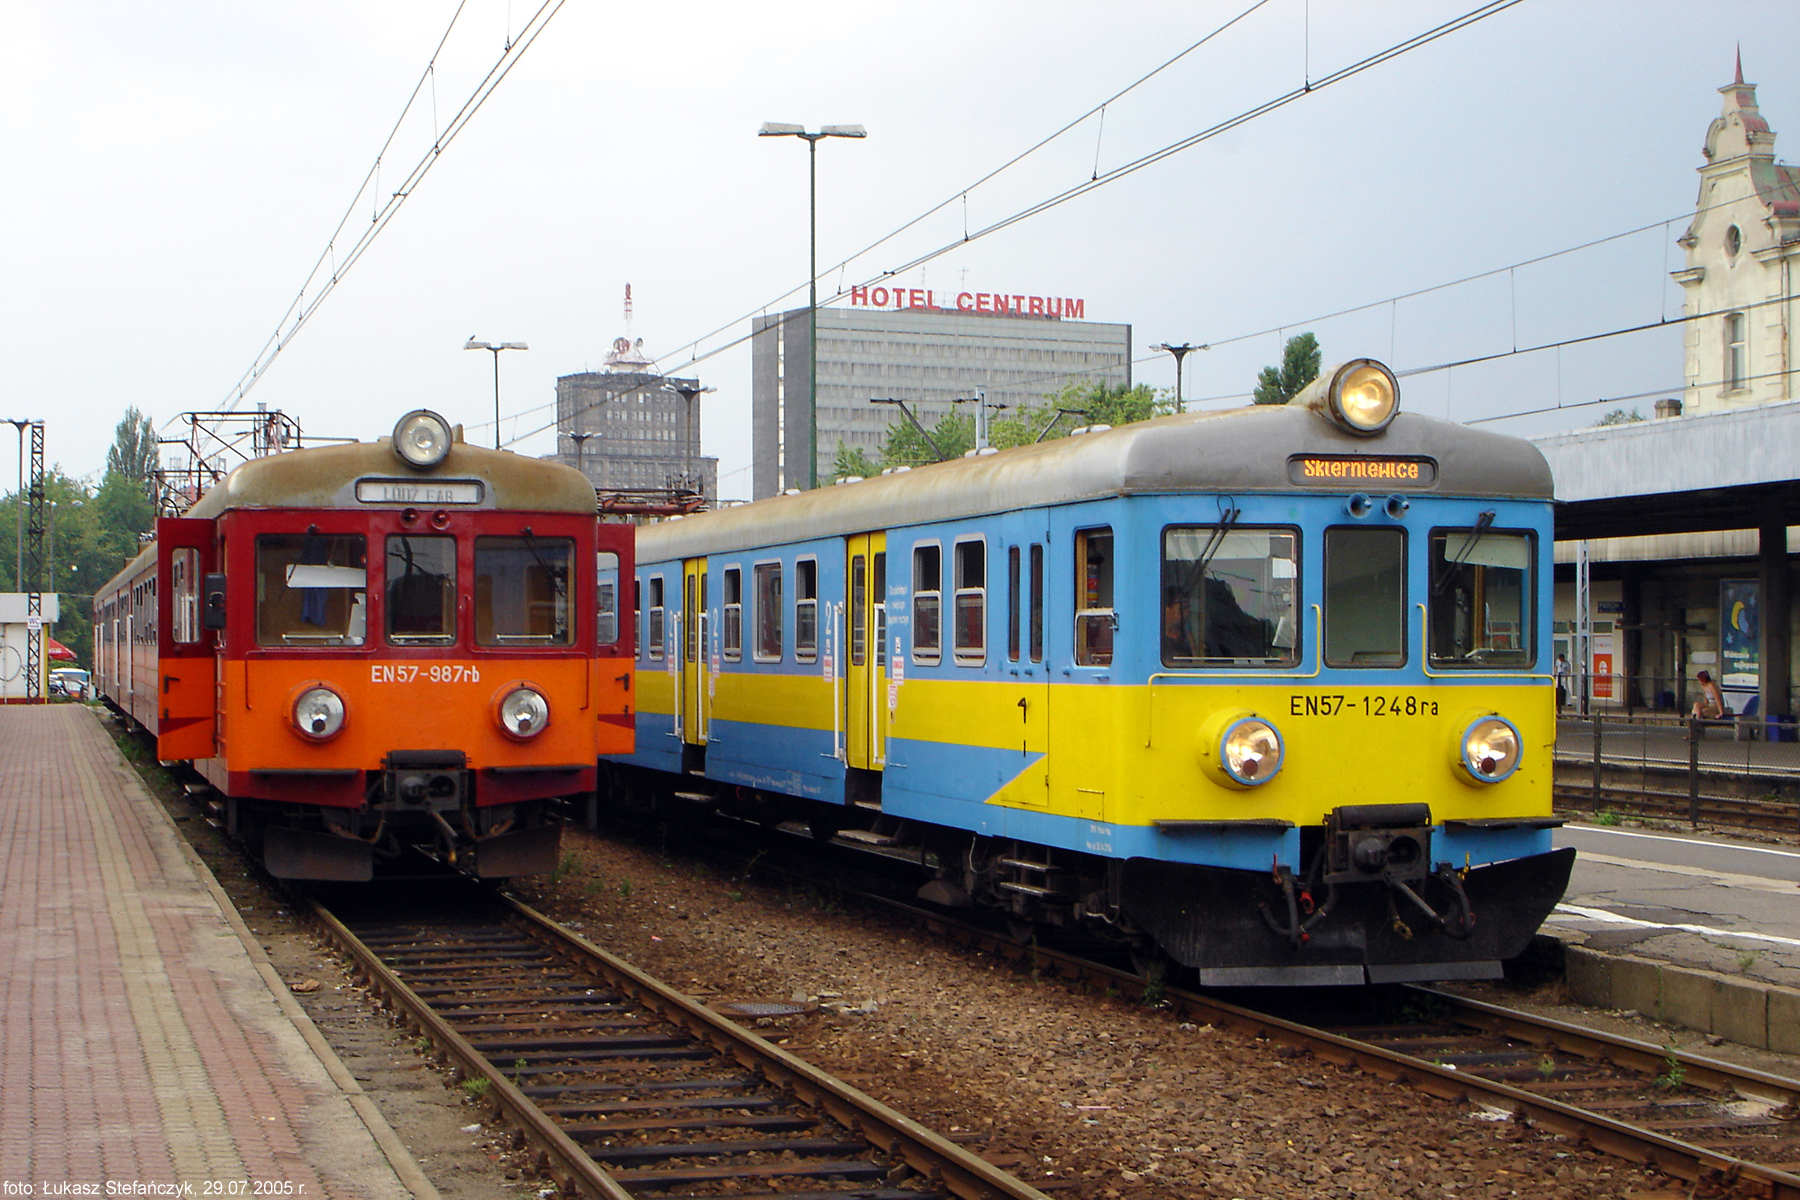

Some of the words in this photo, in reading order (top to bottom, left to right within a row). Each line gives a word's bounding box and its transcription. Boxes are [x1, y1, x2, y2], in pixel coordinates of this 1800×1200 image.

[851, 285, 940, 310] HOTEL
[956, 291, 1085, 319] CENTRUM
[371, 665, 480, 683] EN57-987rb
[1290, 695, 1439, 716] EN57-1248ra
